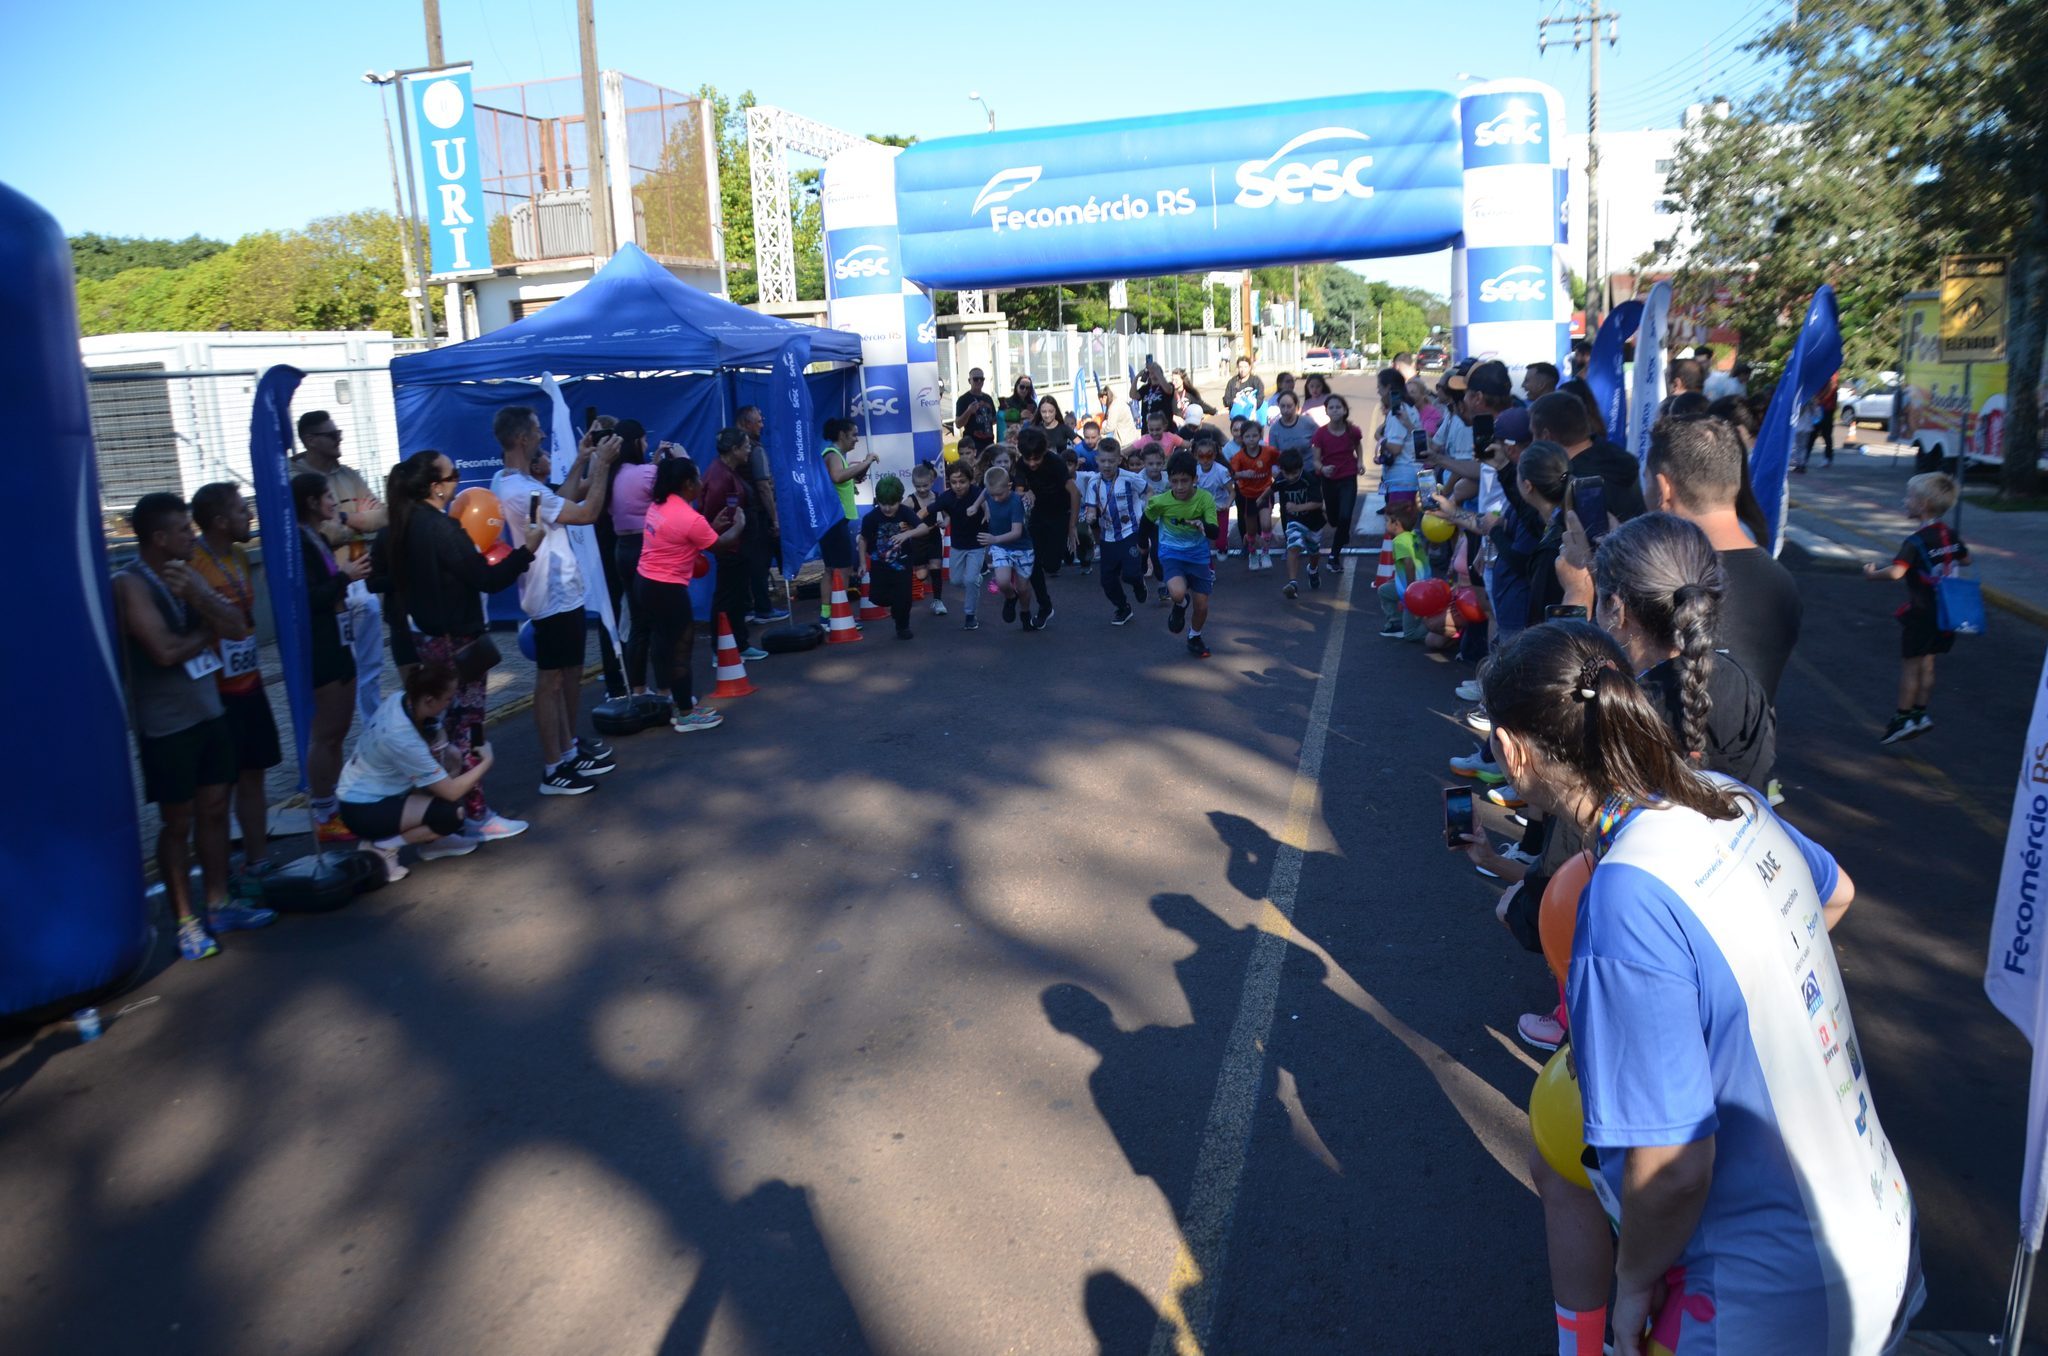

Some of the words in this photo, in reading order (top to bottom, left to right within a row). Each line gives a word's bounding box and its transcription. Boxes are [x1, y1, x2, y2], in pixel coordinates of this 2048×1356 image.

[431, 136, 475, 270] URI
[990, 193, 1149, 232] Fecomércio
[1157, 186, 1197, 217] RS
[1235, 130, 1375, 209] Sesc
[2003, 794, 2048, 975] Fecomércio
